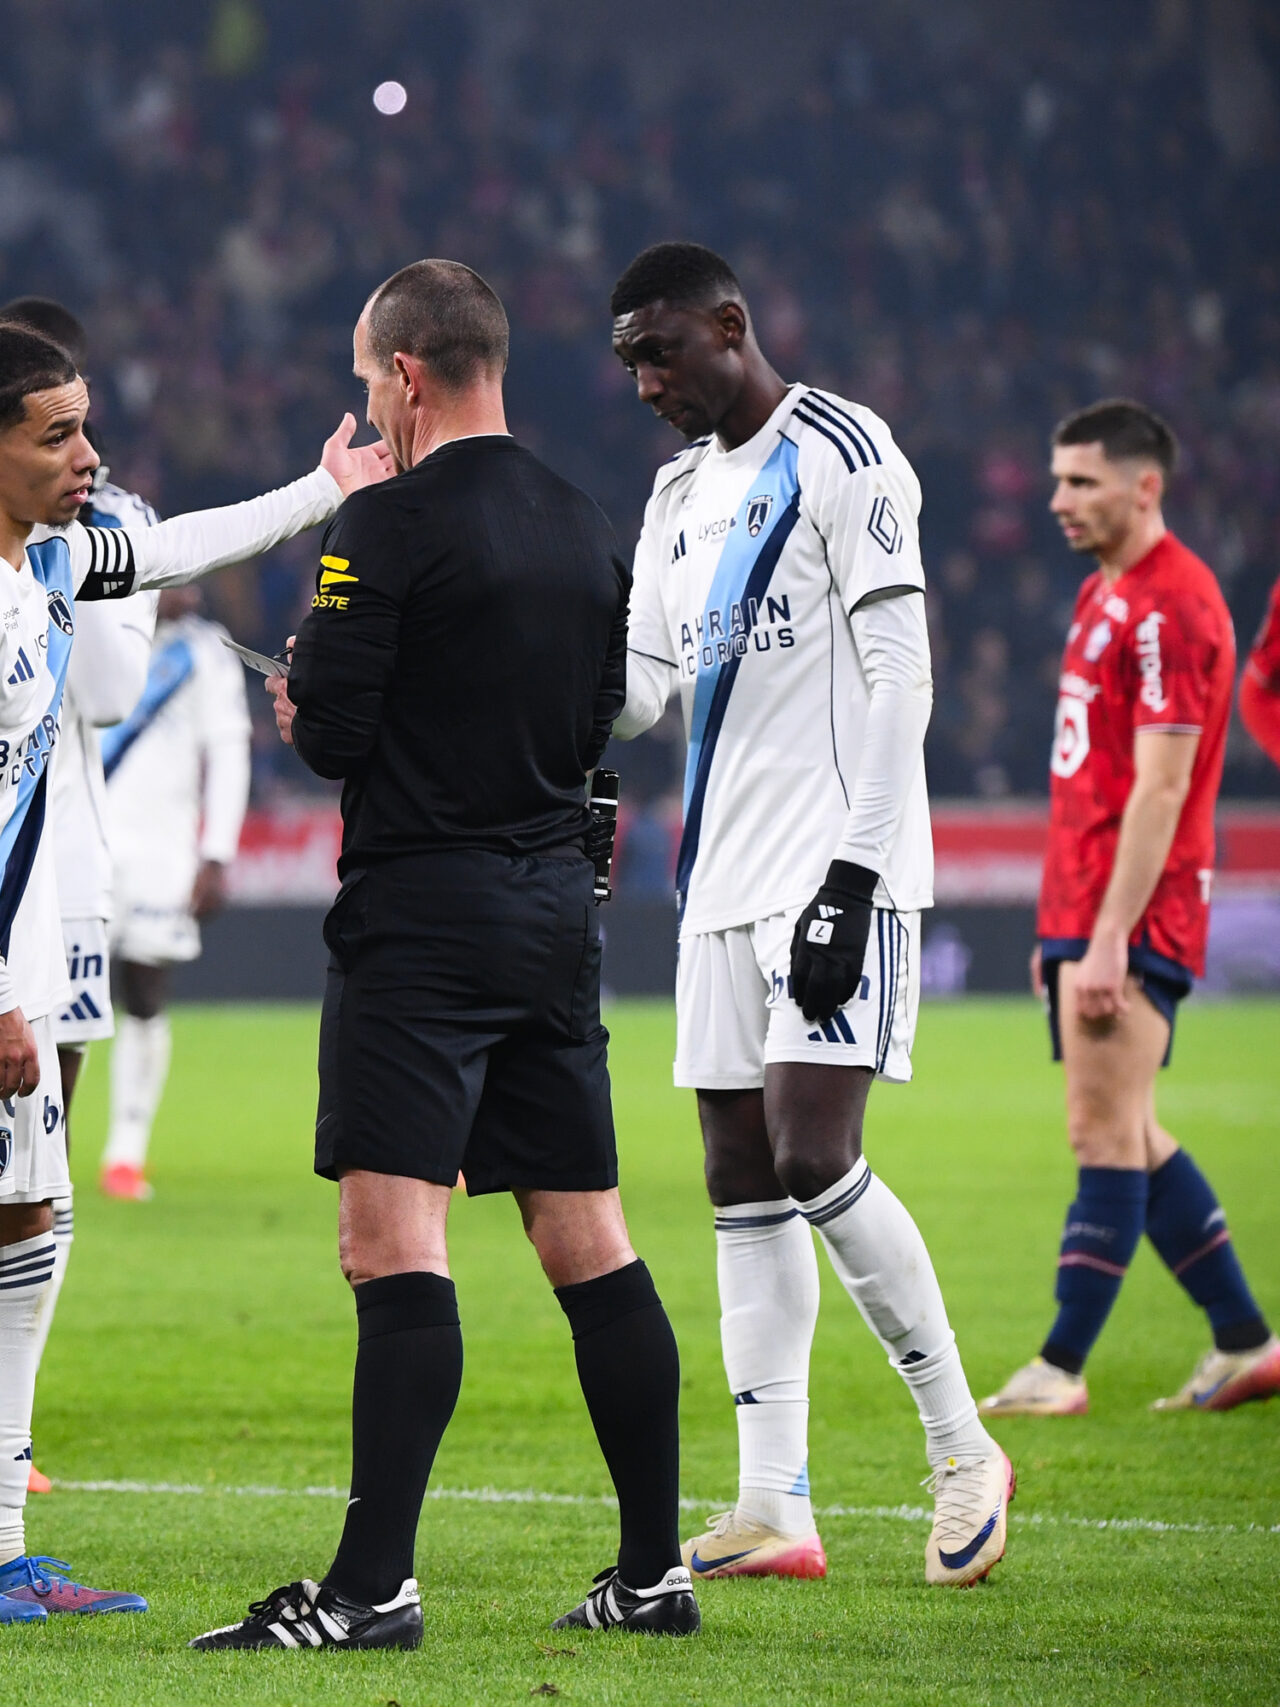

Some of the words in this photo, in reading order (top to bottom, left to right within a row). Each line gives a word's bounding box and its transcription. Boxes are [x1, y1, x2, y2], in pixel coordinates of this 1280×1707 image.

[311, 594, 350, 610] OSTE
[681, 628, 795, 679] ICORIOUS
[67, 944, 102, 980] in
